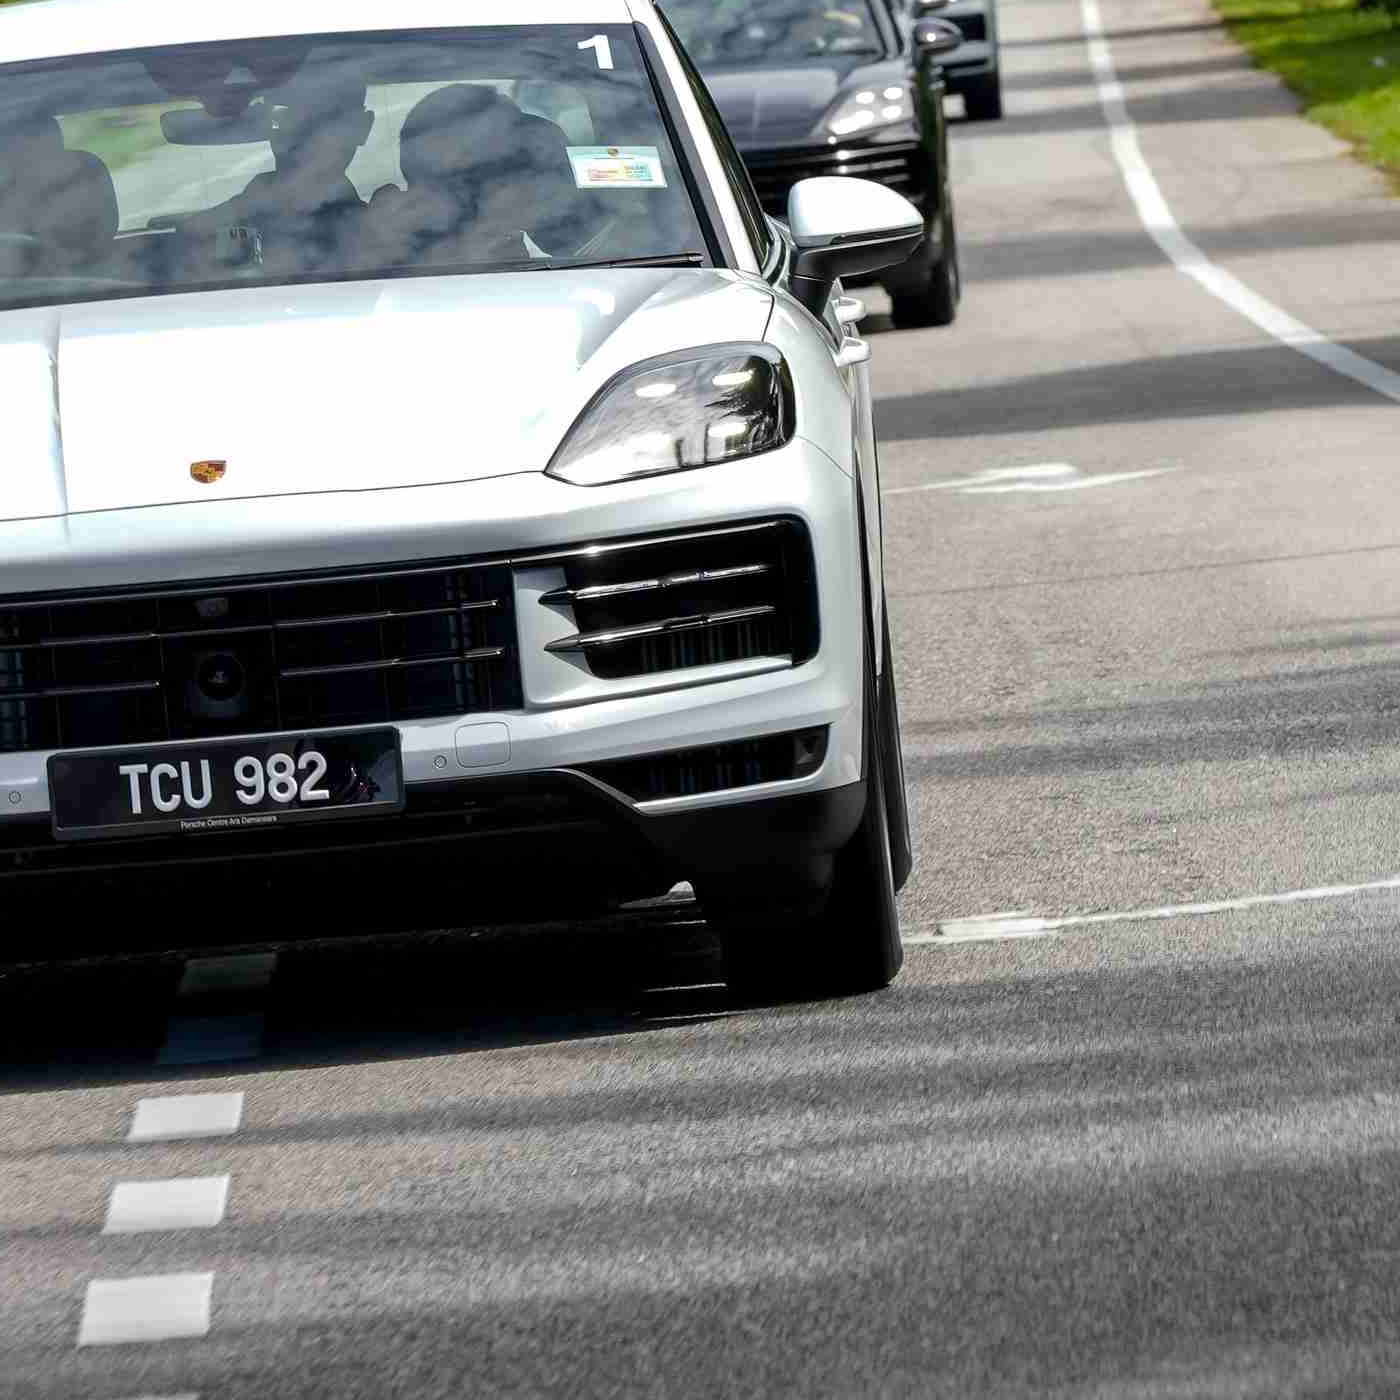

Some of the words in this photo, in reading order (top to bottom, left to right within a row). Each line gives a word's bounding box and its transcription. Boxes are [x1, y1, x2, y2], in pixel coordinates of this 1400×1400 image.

[577, 34, 614, 69] 1
[119, 758, 213, 814] TCU
[233, 750, 330, 805] 982
